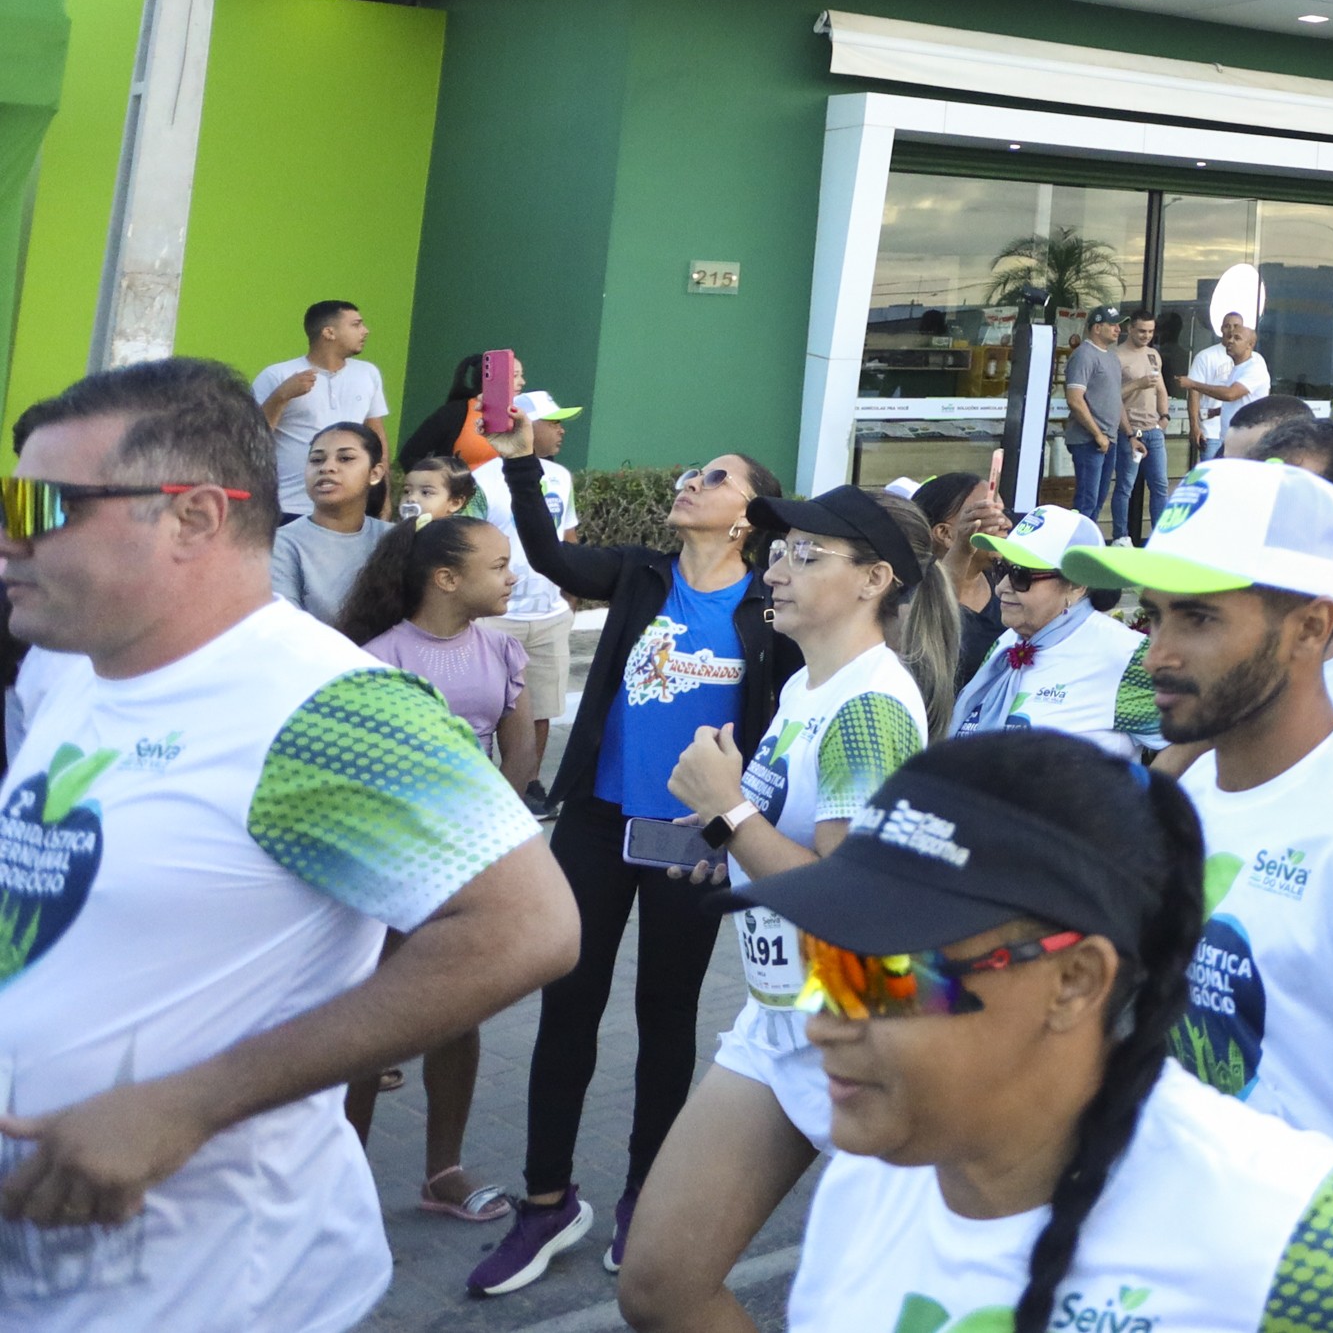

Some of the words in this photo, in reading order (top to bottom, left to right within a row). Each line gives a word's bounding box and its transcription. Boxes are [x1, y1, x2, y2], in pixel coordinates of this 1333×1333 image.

[693, 270, 733, 287] 215
[1254, 849, 1309, 885] Seiva
[1262, 876, 1275, 887] DO
[1279, 880, 1304, 896] VALE
[1195, 937, 1252, 978] ÚSTICA
